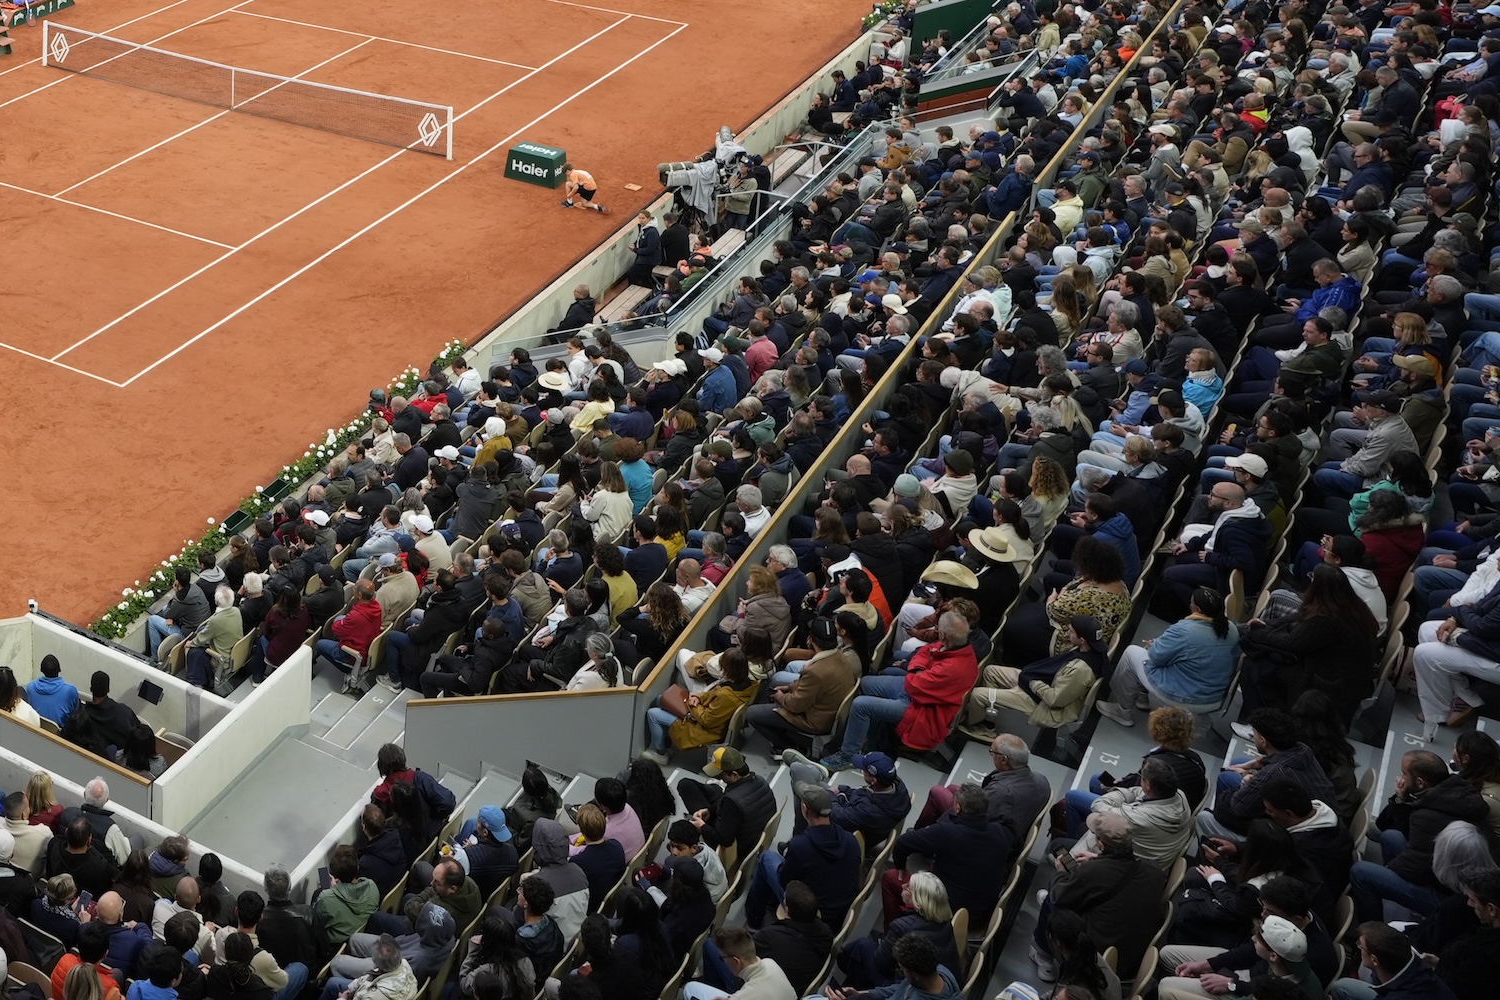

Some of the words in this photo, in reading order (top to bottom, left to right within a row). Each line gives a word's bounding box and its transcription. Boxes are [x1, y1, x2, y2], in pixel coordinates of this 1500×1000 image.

[518, 144, 558, 156] Haier
[512, 158, 548, 178] Haier
[1403, 732, 1424, 748] 15
[1100, 752, 1120, 766] 13
[966, 770, 987, 783] 12
